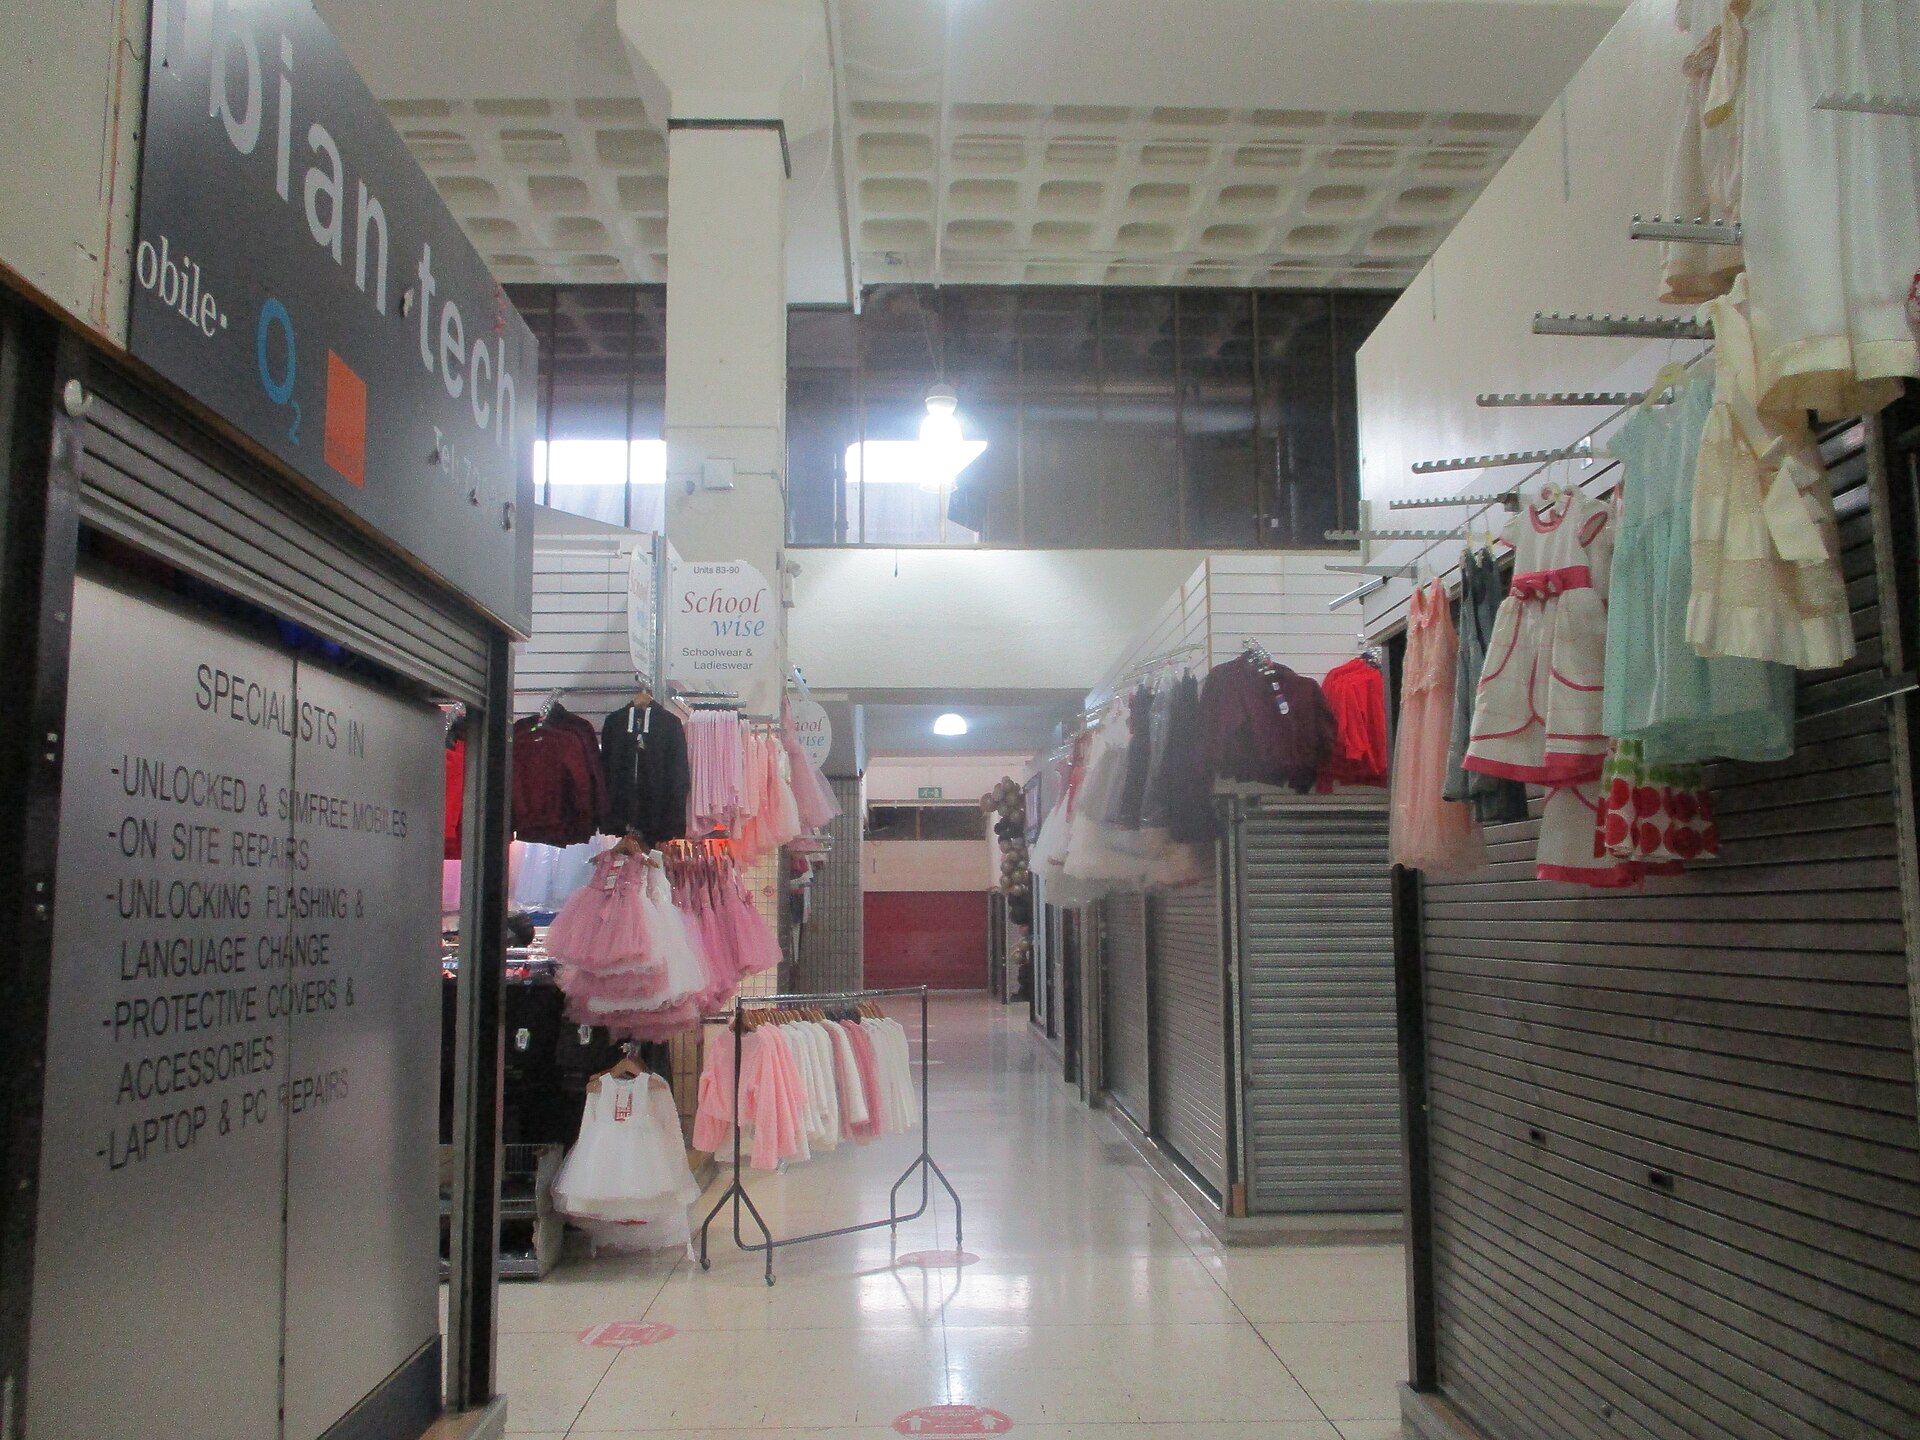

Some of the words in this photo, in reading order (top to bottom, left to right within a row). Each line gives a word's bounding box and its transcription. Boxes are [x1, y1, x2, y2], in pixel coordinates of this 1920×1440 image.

[257, 297, 300, 444] O2
[418, 242, 516, 457] tech
[693, 565, 714, 574] Units
[715, 565, 740, 574] 83-90
[681, 588, 767, 614] School
[712, 615, 765, 637] wise
[682, 647, 743, 657] Schoolwear
[745, 648, 753, 657] &
[694, 661, 753, 670] Ladieswear
[196, 663, 337, 749] SPECIALISTS
[348, 719, 365, 760] IN
[257, 783, 268, 817] &
[352, 801, 408, 838] MOBILES
[172, 823, 220, 864] SITE
[232, 831, 309, 871] REPAIRS
[267, 885, 347, 919] FLASHING
[355, 888, 364, 918] &
[121, 936, 246, 981] LANGUAGE
[258, 933, 330, 970] CHANGE
[268, 979, 337, 1018] COVERS
[345, 976, 354, 1006] &
[116, 1035, 274, 1105] ACCESSORIES
[219, 1099, 230, 1136] &
[242, 1088, 267, 1128] PC
[277, 1067, 348, 1114] REPAIRS
